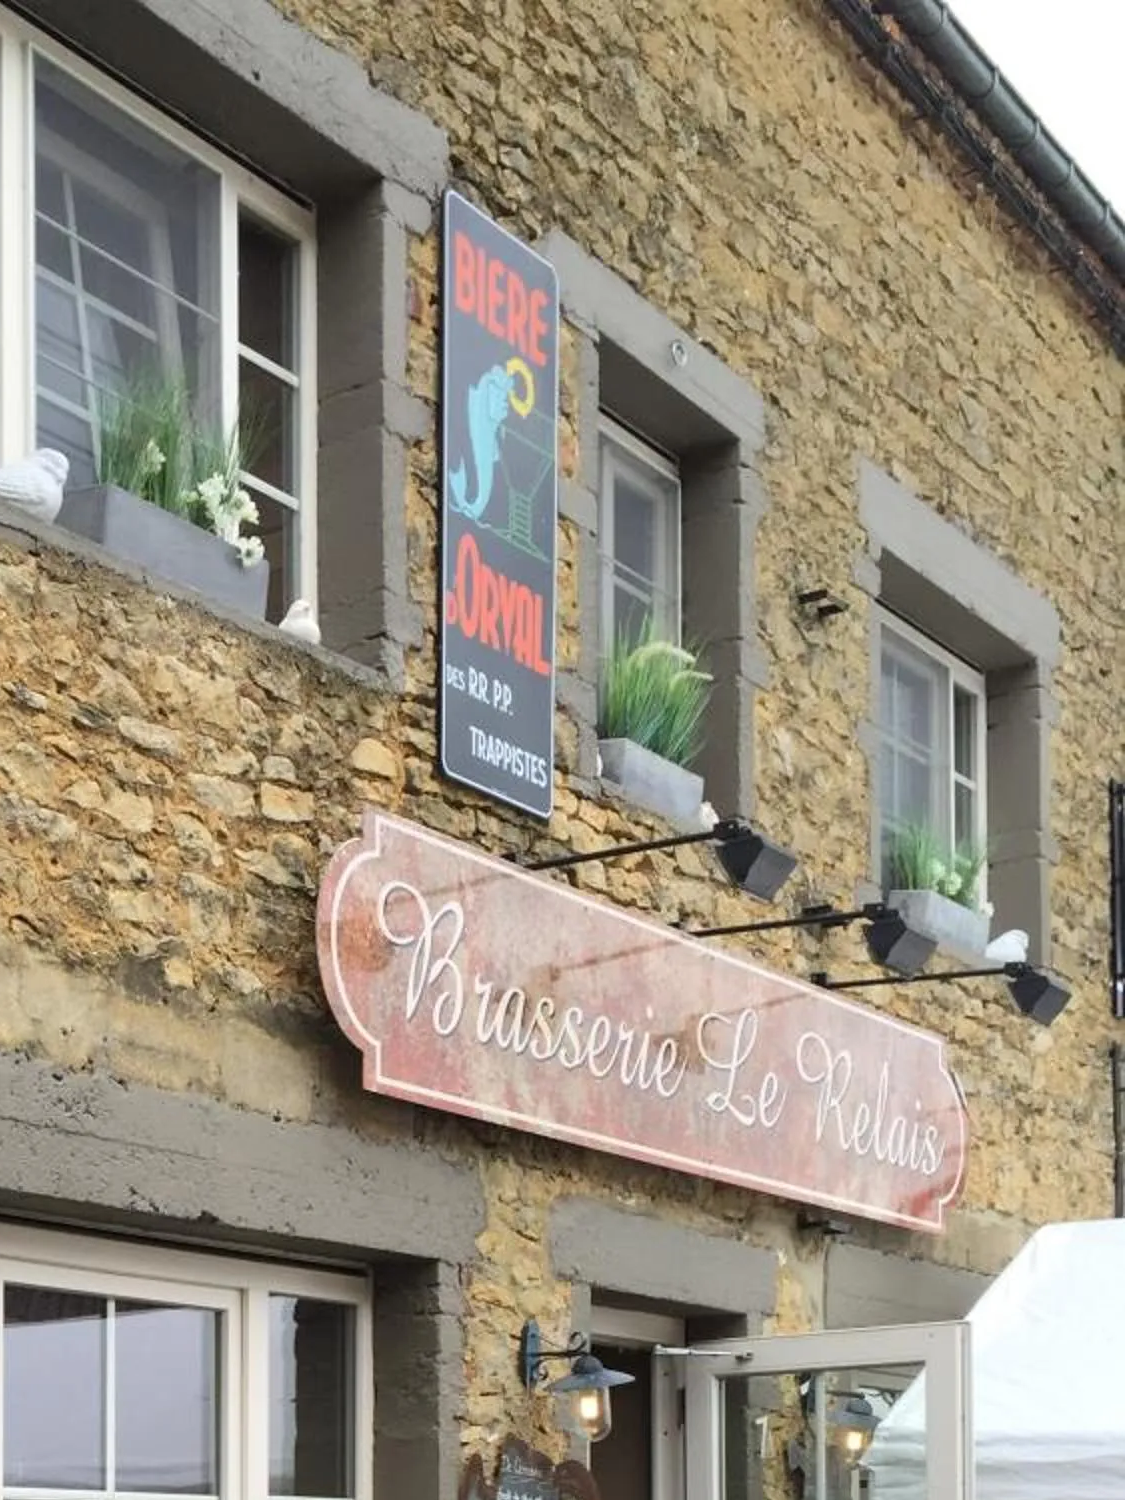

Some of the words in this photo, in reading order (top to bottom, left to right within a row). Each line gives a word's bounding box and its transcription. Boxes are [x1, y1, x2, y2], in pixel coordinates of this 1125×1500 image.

[453, 230, 550, 367] BIERE
[445, 663, 465, 692] DES
[469, 725, 548, 789] TRAPPISTES
[378, 880, 687, 1098] Brasserie
[697, 1008, 788, 1126] Le
[796, 1031, 944, 1176] Relais
